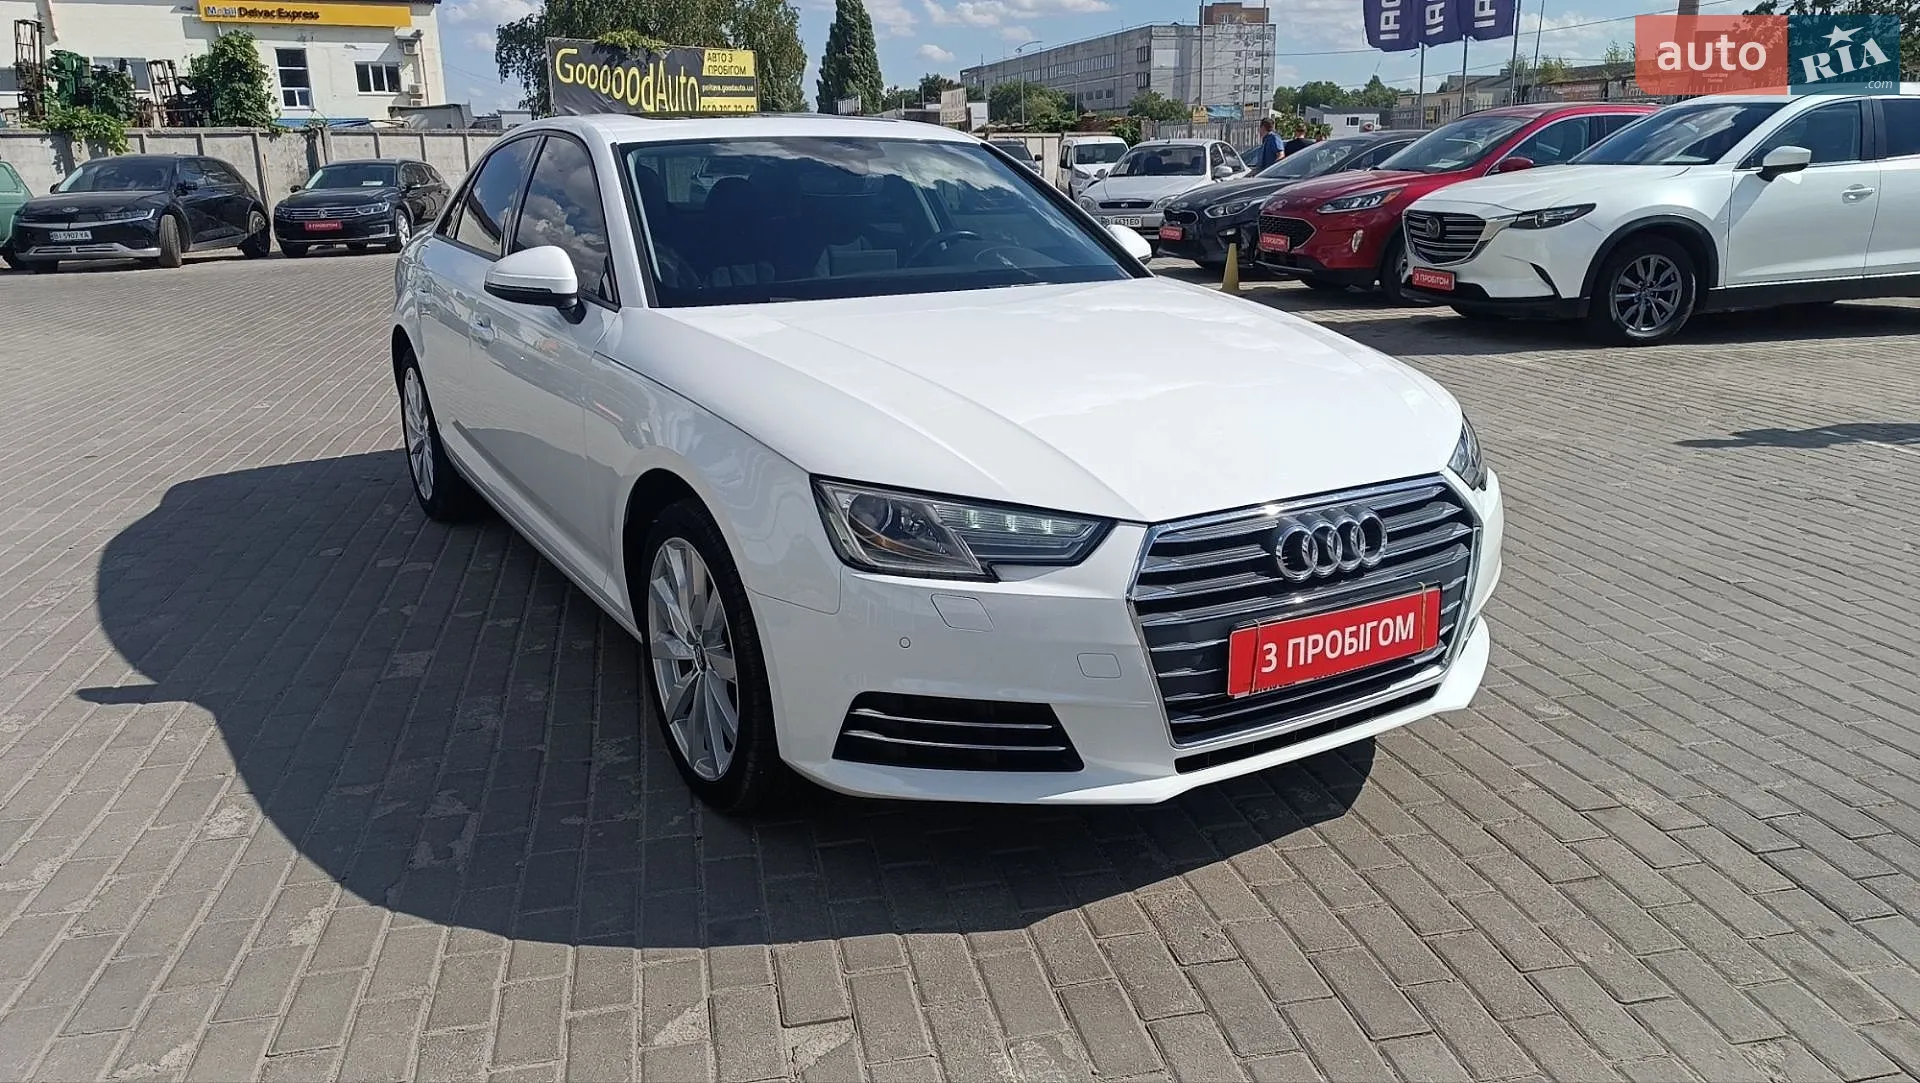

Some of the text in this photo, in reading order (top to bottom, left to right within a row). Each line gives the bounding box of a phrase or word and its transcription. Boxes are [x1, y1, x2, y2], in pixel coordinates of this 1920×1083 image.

[206, 6, 237, 17] Mobil
[277, 8, 320, 21] Express
[707, 52, 727, 63] АВТО
[708, 65, 747, 75] ПРОБІГОМ
[1261, 612, 1415, 673] З ПРОБІГОМ
